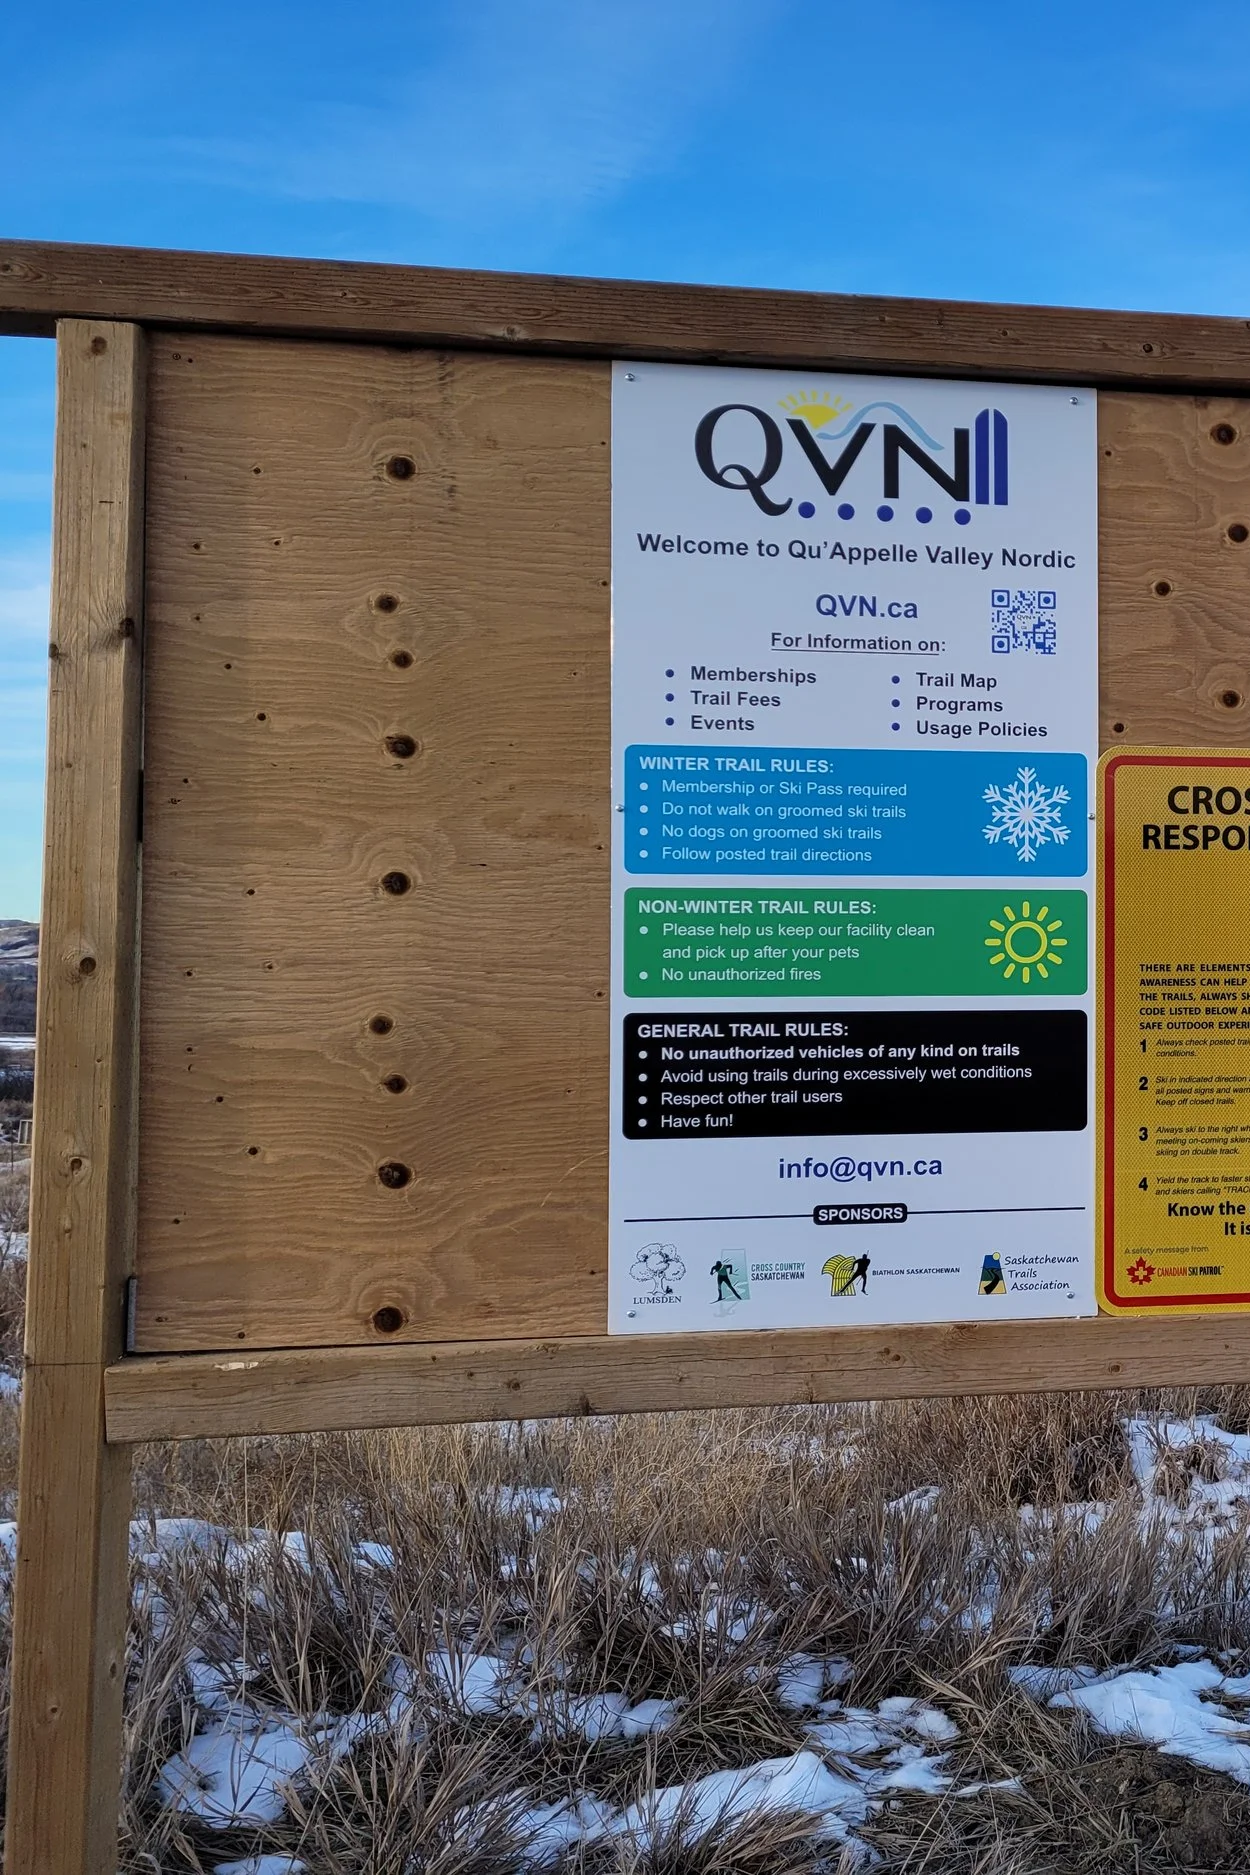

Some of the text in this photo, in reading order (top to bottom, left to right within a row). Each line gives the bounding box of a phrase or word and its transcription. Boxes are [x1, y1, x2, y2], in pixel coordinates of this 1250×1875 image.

[694, 403, 971, 517] QVN
[637, 533, 748, 556] Welcome
[756, 539, 779, 557] to
[925, 545, 993, 569] Valley
[1002, 548, 1075, 568] Nordic
[816, 593, 917, 619] QVN.ca
[771, 632, 945, 651] For Information on:
[691, 665, 816, 687] Memberships
[915, 672, 997, 691] Trail Map
[690, 690, 780, 706] Trail Fees
[916, 696, 1003, 715] Programs
[691, 715, 754, 730] Events
[917, 720, 1047, 739] Usage Policies
[639, 756, 833, 773] WINTER TRAIL RULES:
[662, 779, 906, 799] Membership or Ski Pass required
[662, 801, 906, 820] Do not walk on groomed ski trails
[662, 824, 882, 842] No dogs on groomed ski trails
[662, 847, 872, 862] Follow posted trail directions
[638, 899, 876, 914] NON-WINTER TRAIL RULES:
[663, 922, 934, 939] Please help us keep our facility clean
[662, 945, 859, 961] and pick up after your pets
[662, 967, 821, 980] No unauthorized fires
[1140, 963, 1170, 972] THERE
[1176, 963, 1194, 972] ARE
[1200, 963, 1250, 972] ELEMENTS
[637, 1022, 848, 1038] GENERAL TRAIL RULES:
[1139, 1021, 1162, 1030] SAFE
[1166, 1021, 1214, 1029] OUTDOOR
[661, 1043, 1019, 1060] No unauthorized vehicles of any kind on trails
[660, 1065, 1032, 1085] Avoid using trails during excessively wet conditions
[661, 1090, 842, 1108] Respect other trail users
[661, 1113, 733, 1128] Have fun!
[779, 1155, 942, 1183] info@qvn.ca
[1138, 1176, 1149, 1192] 4
[818, 1207, 903, 1221] SPONSORS
[1168, 1202, 1214, 1216] Know
[1218, 1200, 1246, 1215] the
[1224, 1221, 1236, 1235] It
[751, 1262, 805, 1272] CROSS COUNTRY
[1004, 1253, 1079, 1265] Saskatchewan
[751, 1271, 804, 1281] SASKATCHEWAN
[1007, 1267, 1037, 1278] Trails
[1010, 1279, 1069, 1291] Association
[633, 1295, 681, 1305] LUMSDEN
